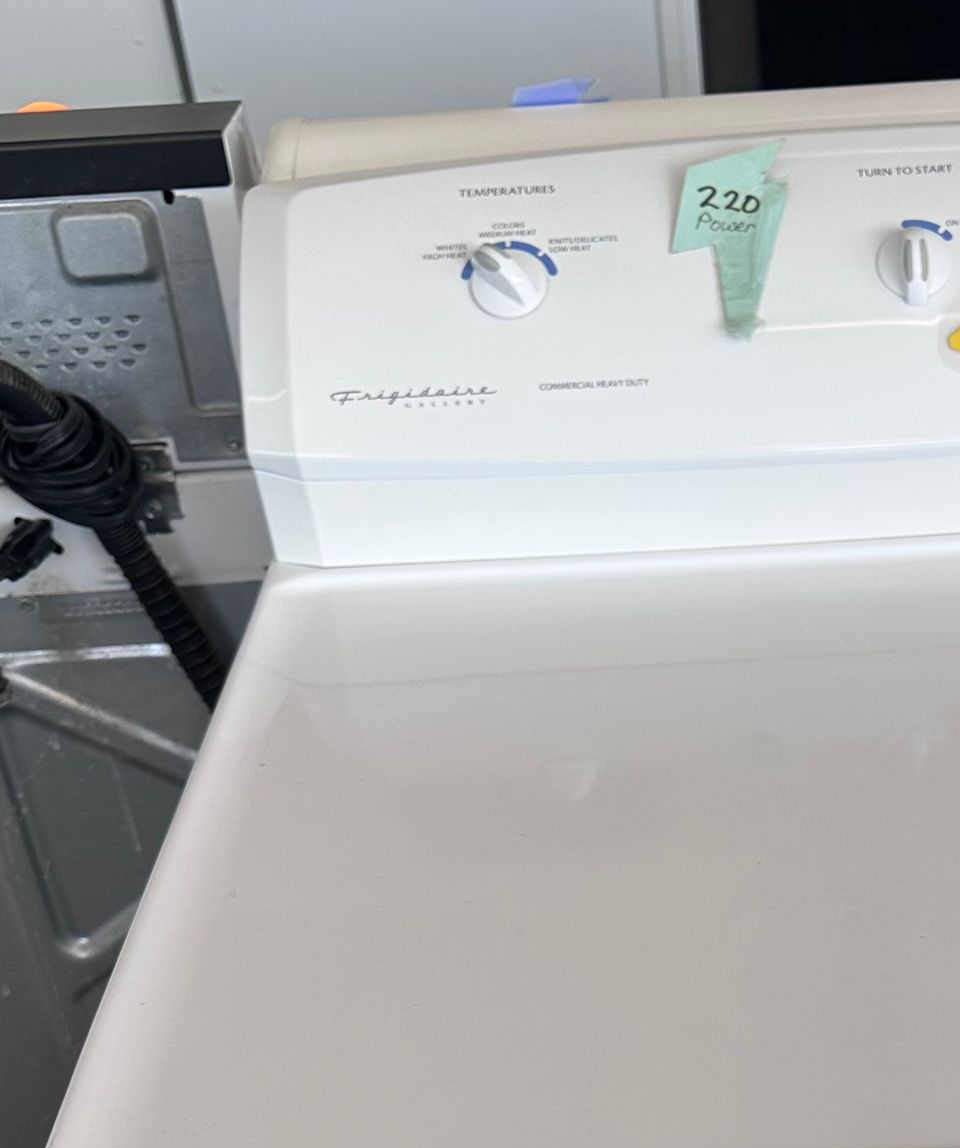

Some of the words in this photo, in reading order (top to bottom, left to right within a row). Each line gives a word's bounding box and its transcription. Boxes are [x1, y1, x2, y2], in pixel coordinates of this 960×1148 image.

[857, 168, 893, 178] TURN
[895, 166, 914, 176] TO
[915, 164, 952, 175] START
[459, 184, 556, 199] TEMPERATURES
[696, 185, 761, 214] 220
[694, 212, 757, 233] Power
[538, 380, 595, 392] COMMERCIAL
[595, 379, 623, 389] HEAVY
[624, 378, 650, 387] DUTY
[329, 386, 497, 405] Frigidaire
